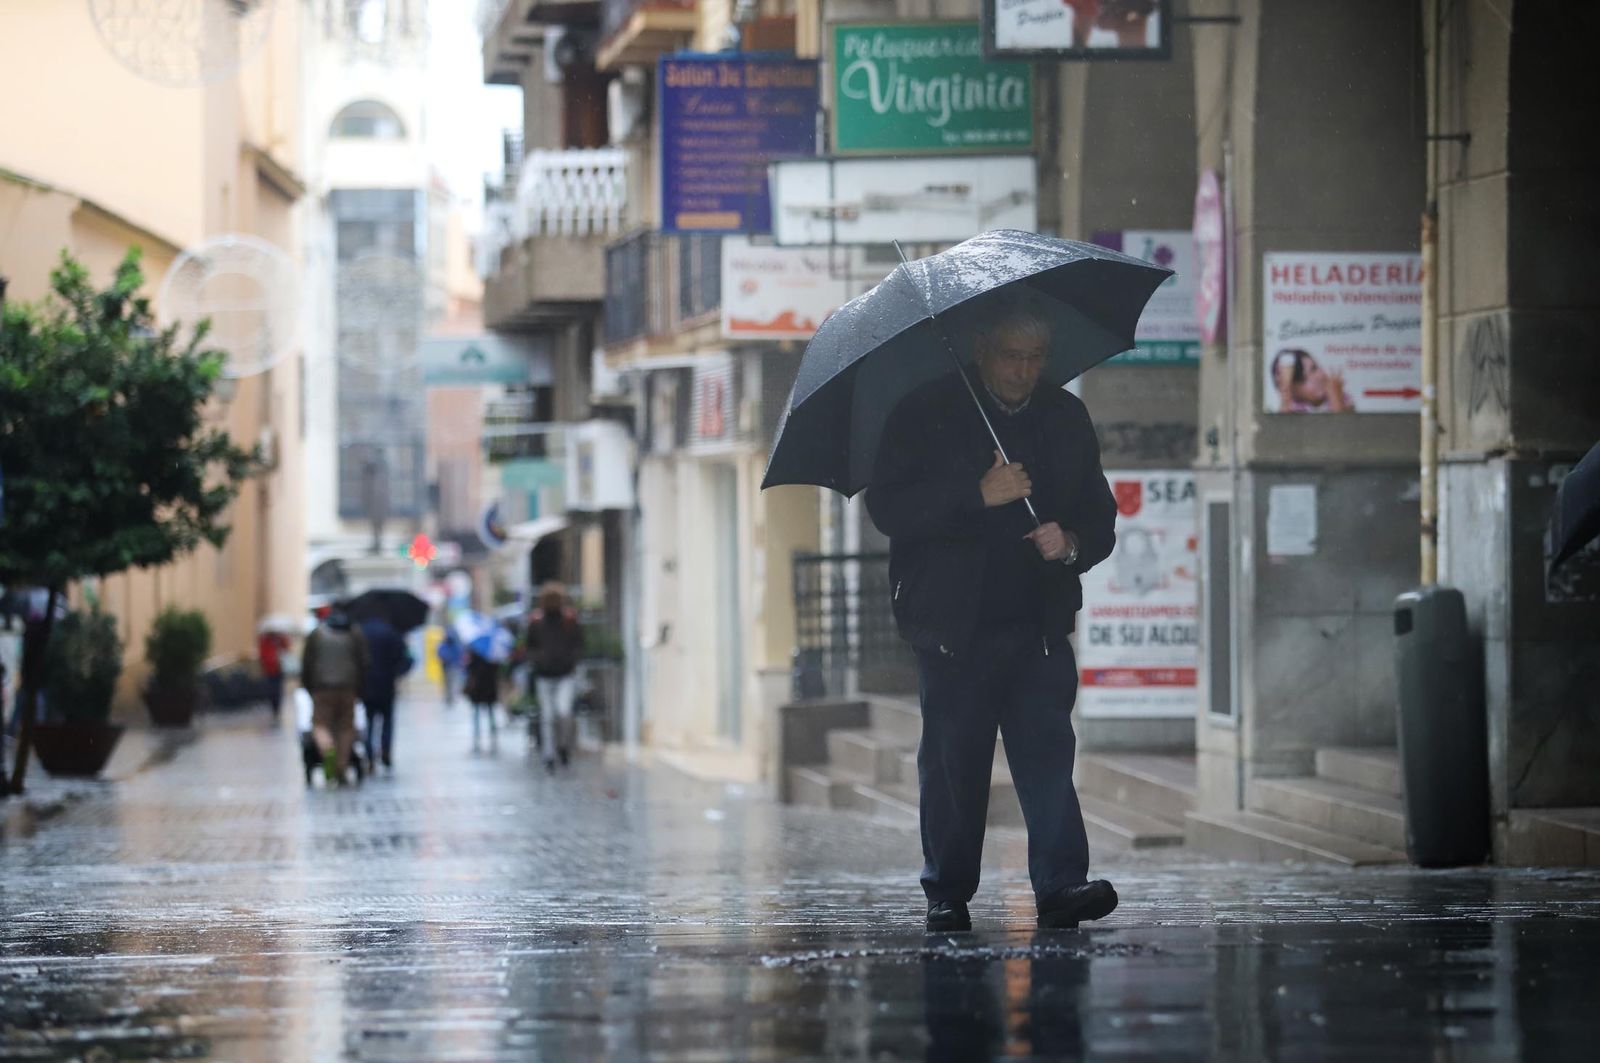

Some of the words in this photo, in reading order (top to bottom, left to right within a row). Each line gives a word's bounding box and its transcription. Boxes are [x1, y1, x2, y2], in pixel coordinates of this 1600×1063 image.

[841, 60, 1025, 127] Virginia
[1089, 624, 1112, 646] DE
[1119, 624, 1143, 646] SU
